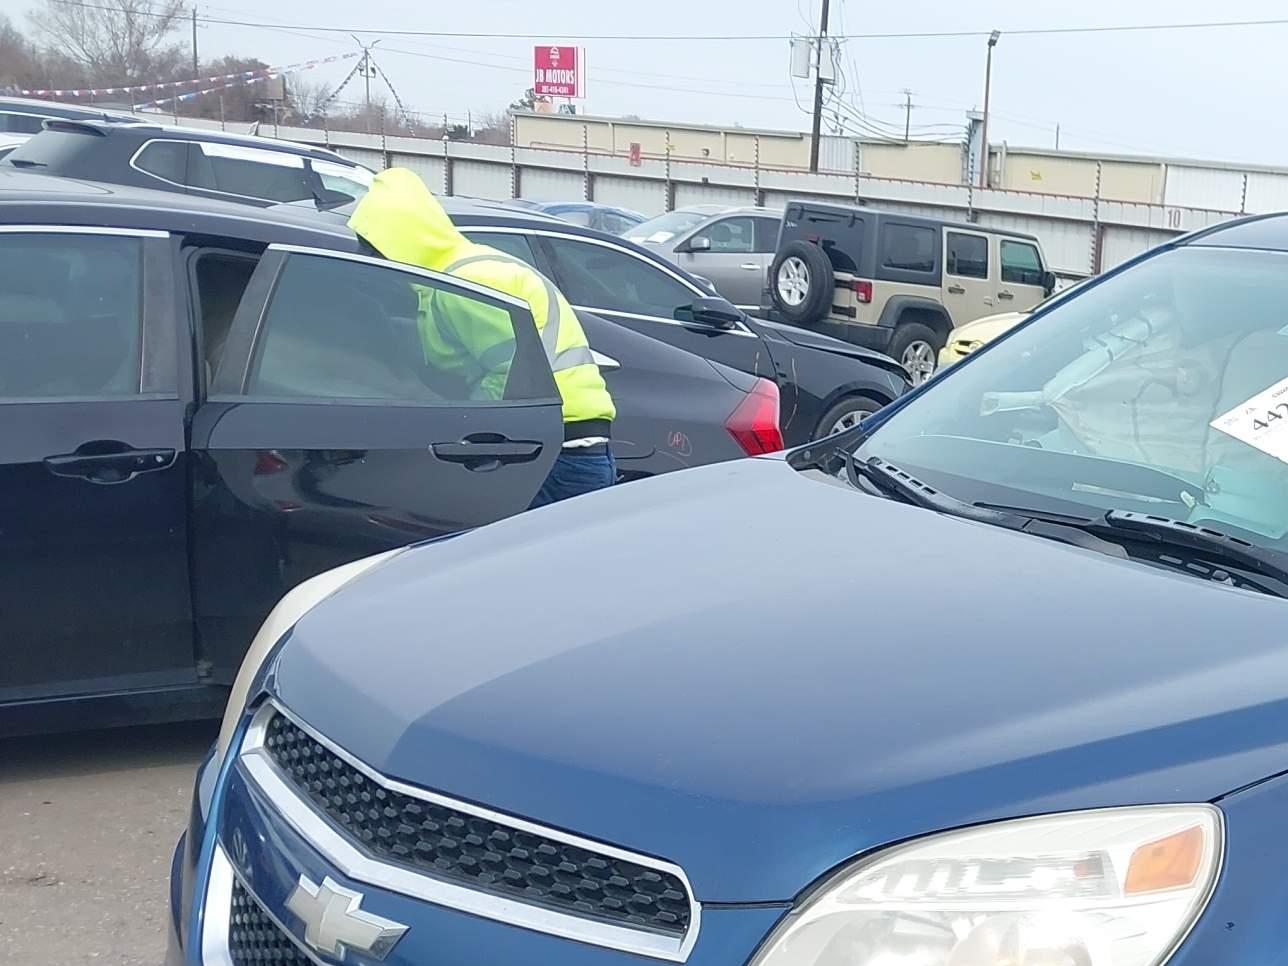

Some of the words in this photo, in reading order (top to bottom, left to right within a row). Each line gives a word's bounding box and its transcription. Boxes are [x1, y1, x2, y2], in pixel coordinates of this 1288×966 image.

[536, 69, 544, 83] JB
[545, 69, 574, 84] MOTORS
[1168, 209, 1181, 228] 10
